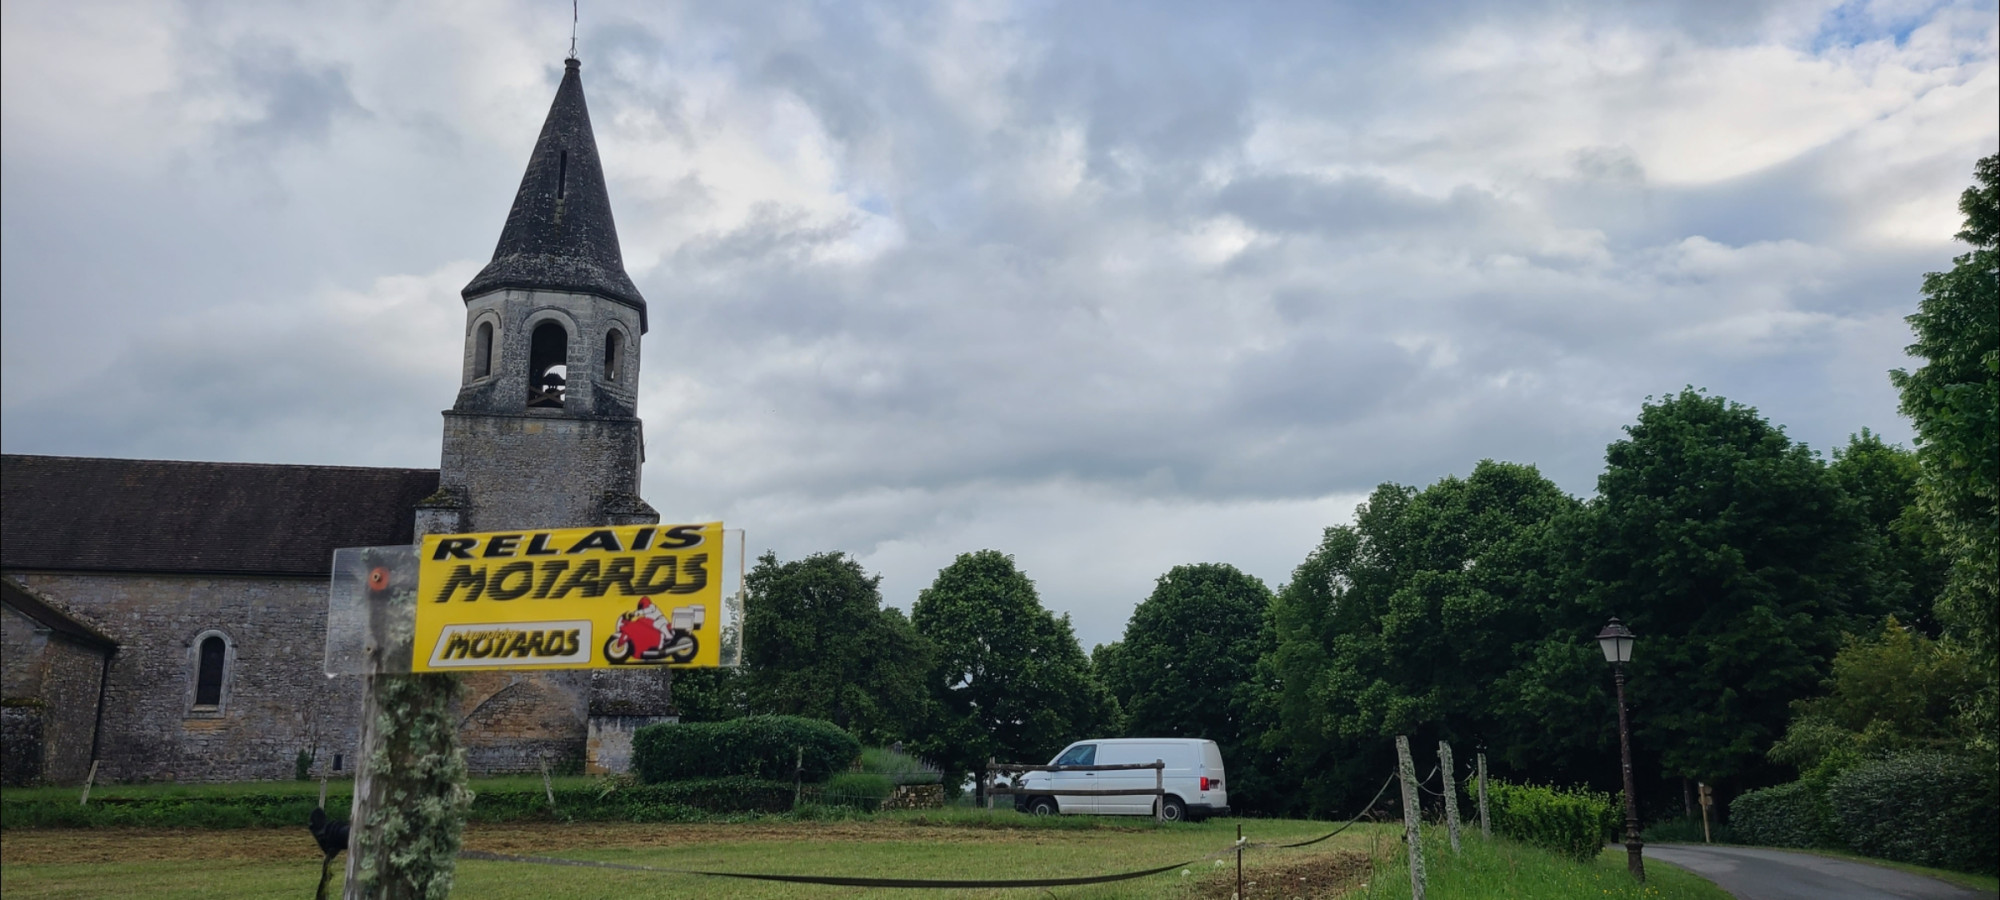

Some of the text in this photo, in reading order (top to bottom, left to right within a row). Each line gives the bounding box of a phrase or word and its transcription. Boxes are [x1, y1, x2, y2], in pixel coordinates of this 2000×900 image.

[432, 525, 707, 561] RELAIS
[434, 553, 709, 603] MOTARDS
[438, 629, 581, 661] MOTARDS
